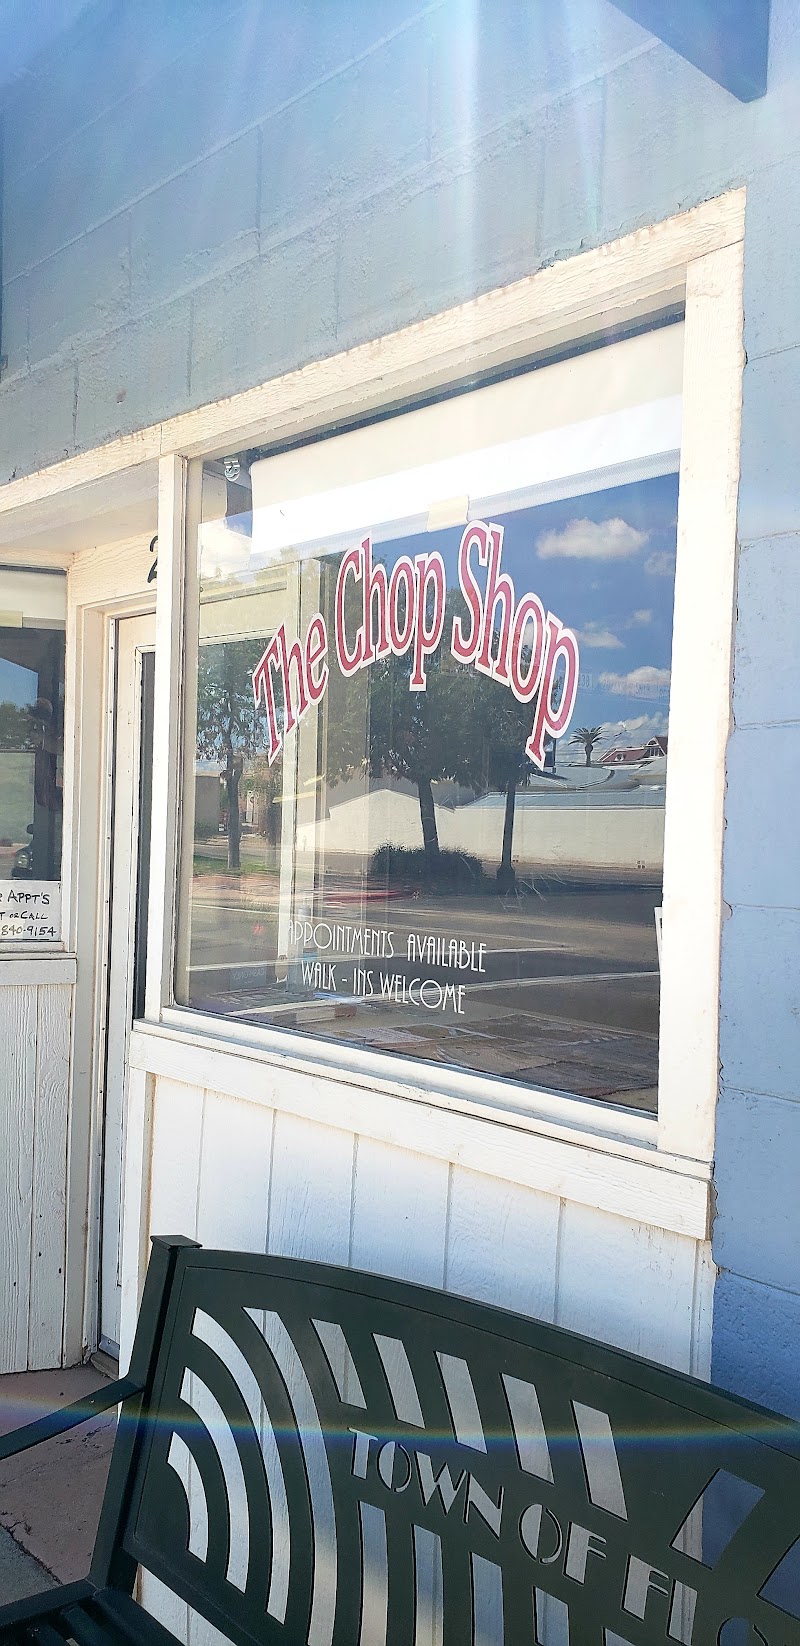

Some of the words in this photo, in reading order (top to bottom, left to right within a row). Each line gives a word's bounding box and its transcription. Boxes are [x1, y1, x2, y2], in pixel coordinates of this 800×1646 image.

[252, 612, 329, 767] The
[335, 530, 446, 692] Chop
[451, 520, 580, 770] Shop
[7, 889, 51, 905] APPT'S
[20, 910, 49, 920] CALL
[1, 924, 57, 937] 840-9154
[288, 919, 395, 959] APPOINTMENTS
[407, 933, 487, 973] AVAILABLE
[301, 960, 337, 991] WALK
[353, 967, 374, 996] INS
[379, 971, 466, 1015] WELCOME
[348, 1427, 504, 1541] TOWN
[518, 1503, 607, 1585] OF
